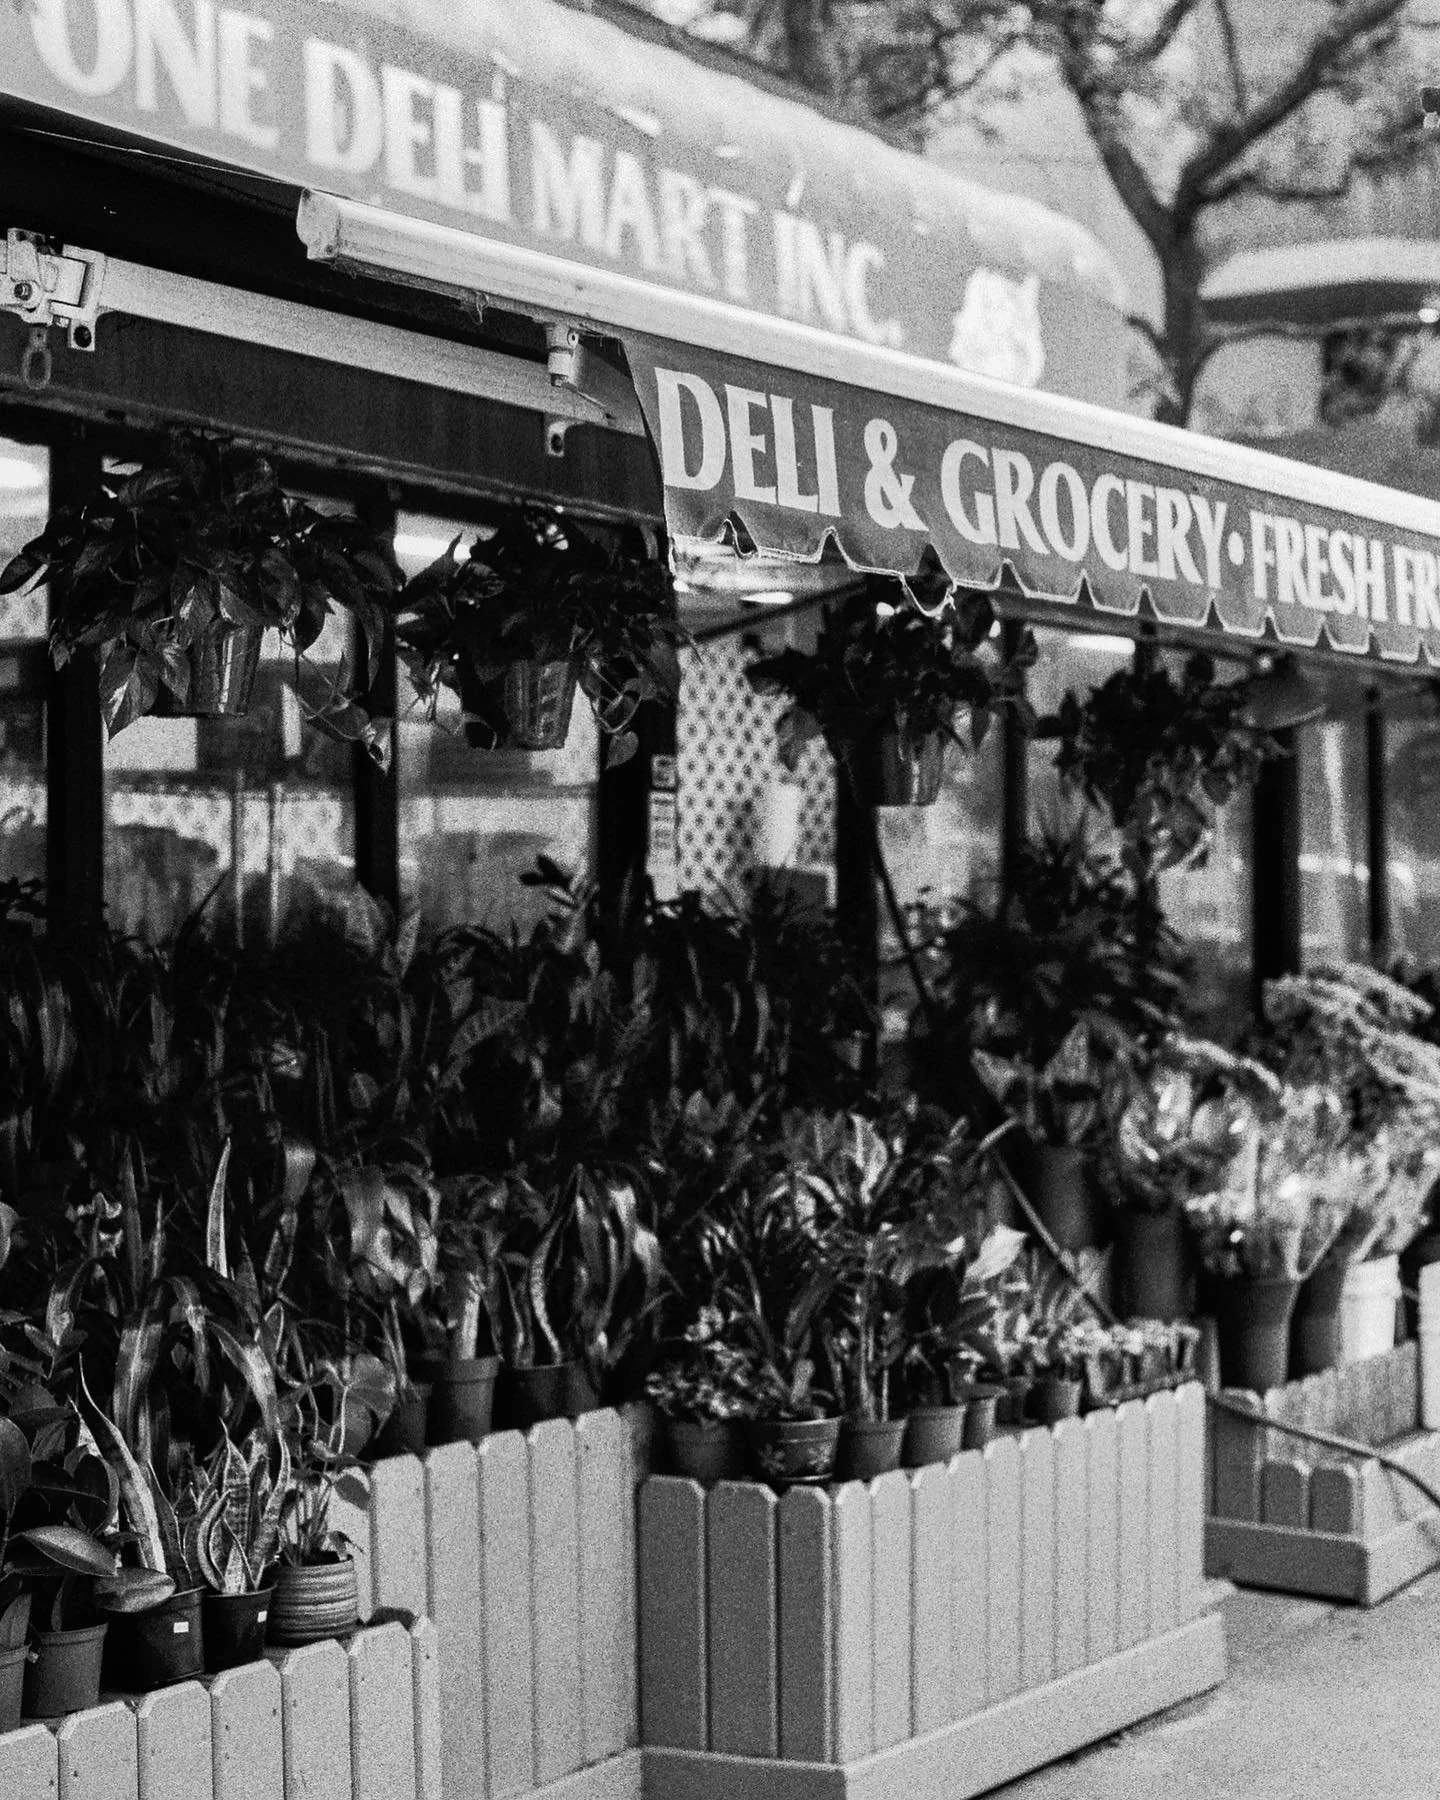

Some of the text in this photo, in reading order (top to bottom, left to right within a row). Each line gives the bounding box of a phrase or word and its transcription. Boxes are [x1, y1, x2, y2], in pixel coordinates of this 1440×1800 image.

[33, 0, 280, 148] ONE
[303, 38, 510, 222] DELI
[530, 118, 760, 300] MART
[654, 367, 1440, 630] DELI & GROCERY FRESH FR
